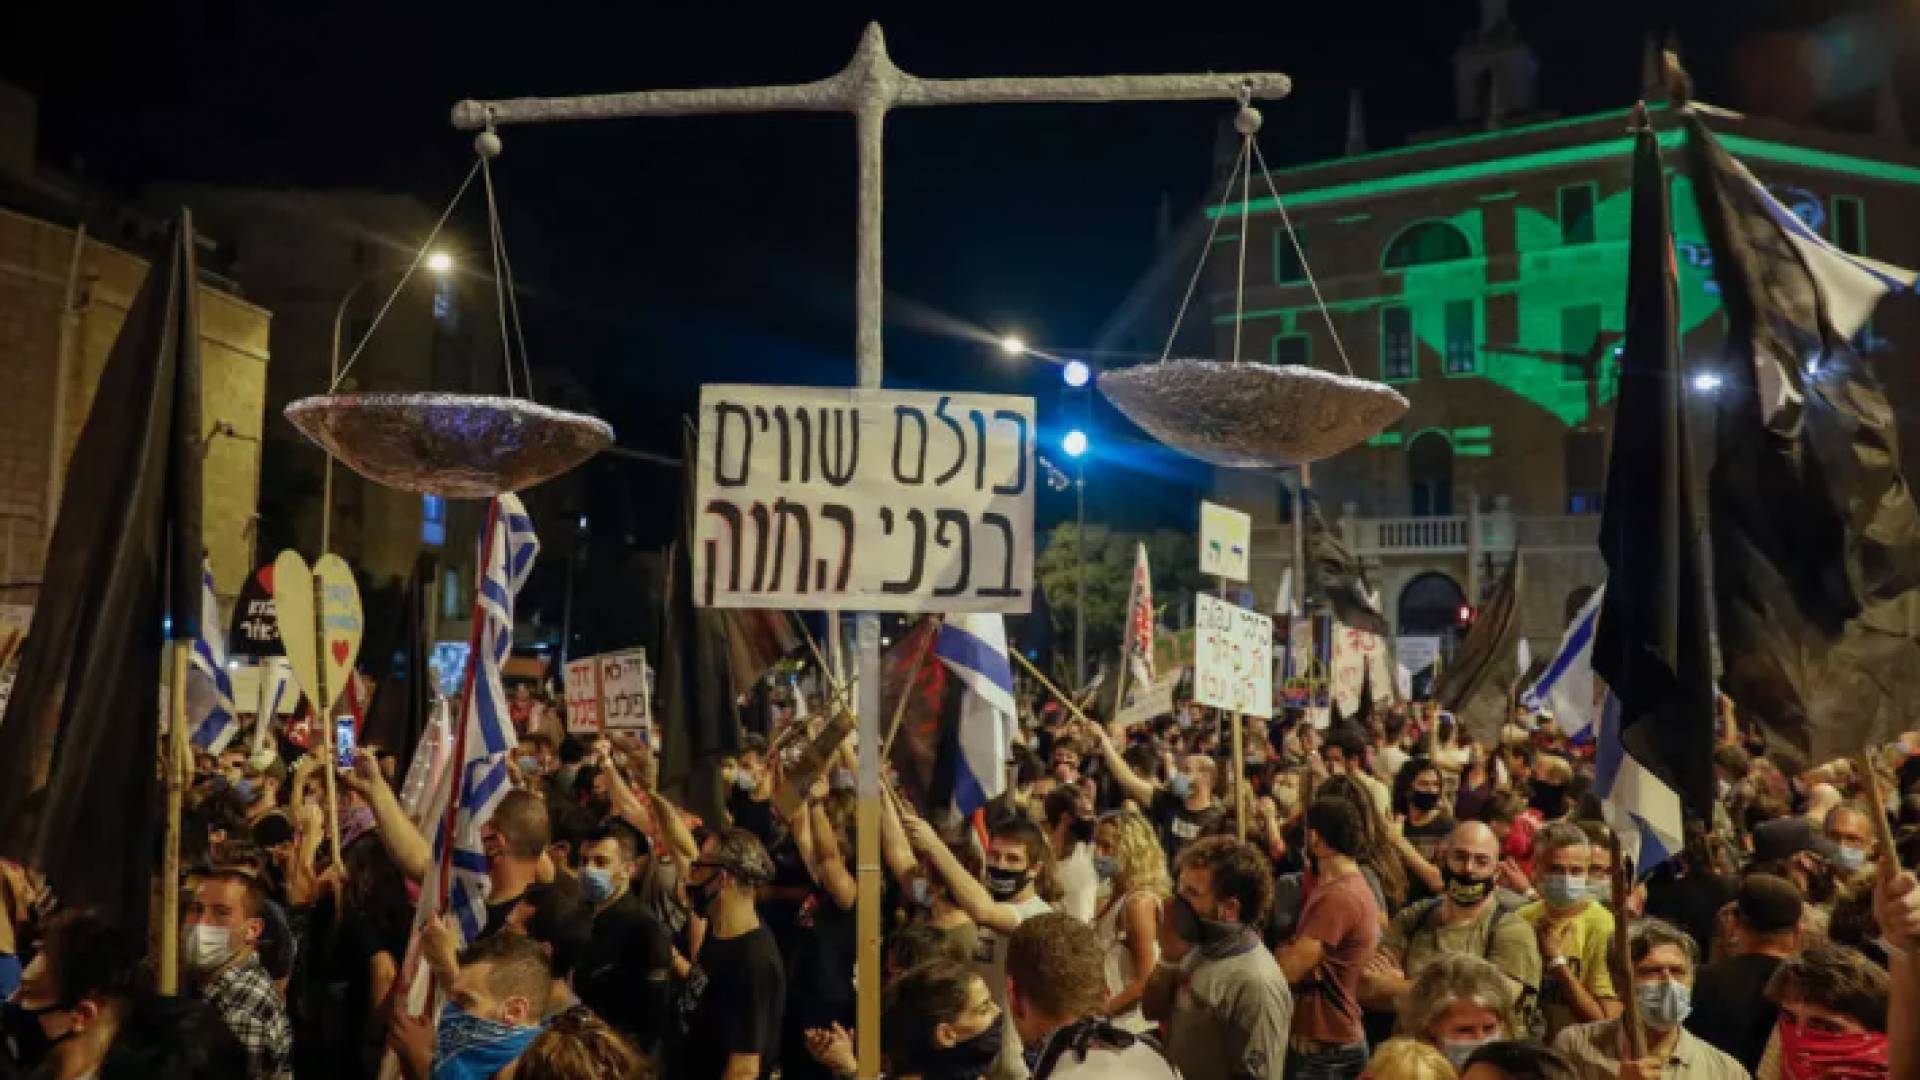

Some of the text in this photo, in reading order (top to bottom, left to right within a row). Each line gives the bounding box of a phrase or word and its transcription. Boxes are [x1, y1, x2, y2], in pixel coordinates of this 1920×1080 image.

[714, 397, 1027, 495] כולם שווים
[879, 506, 1023, 597] בפני
